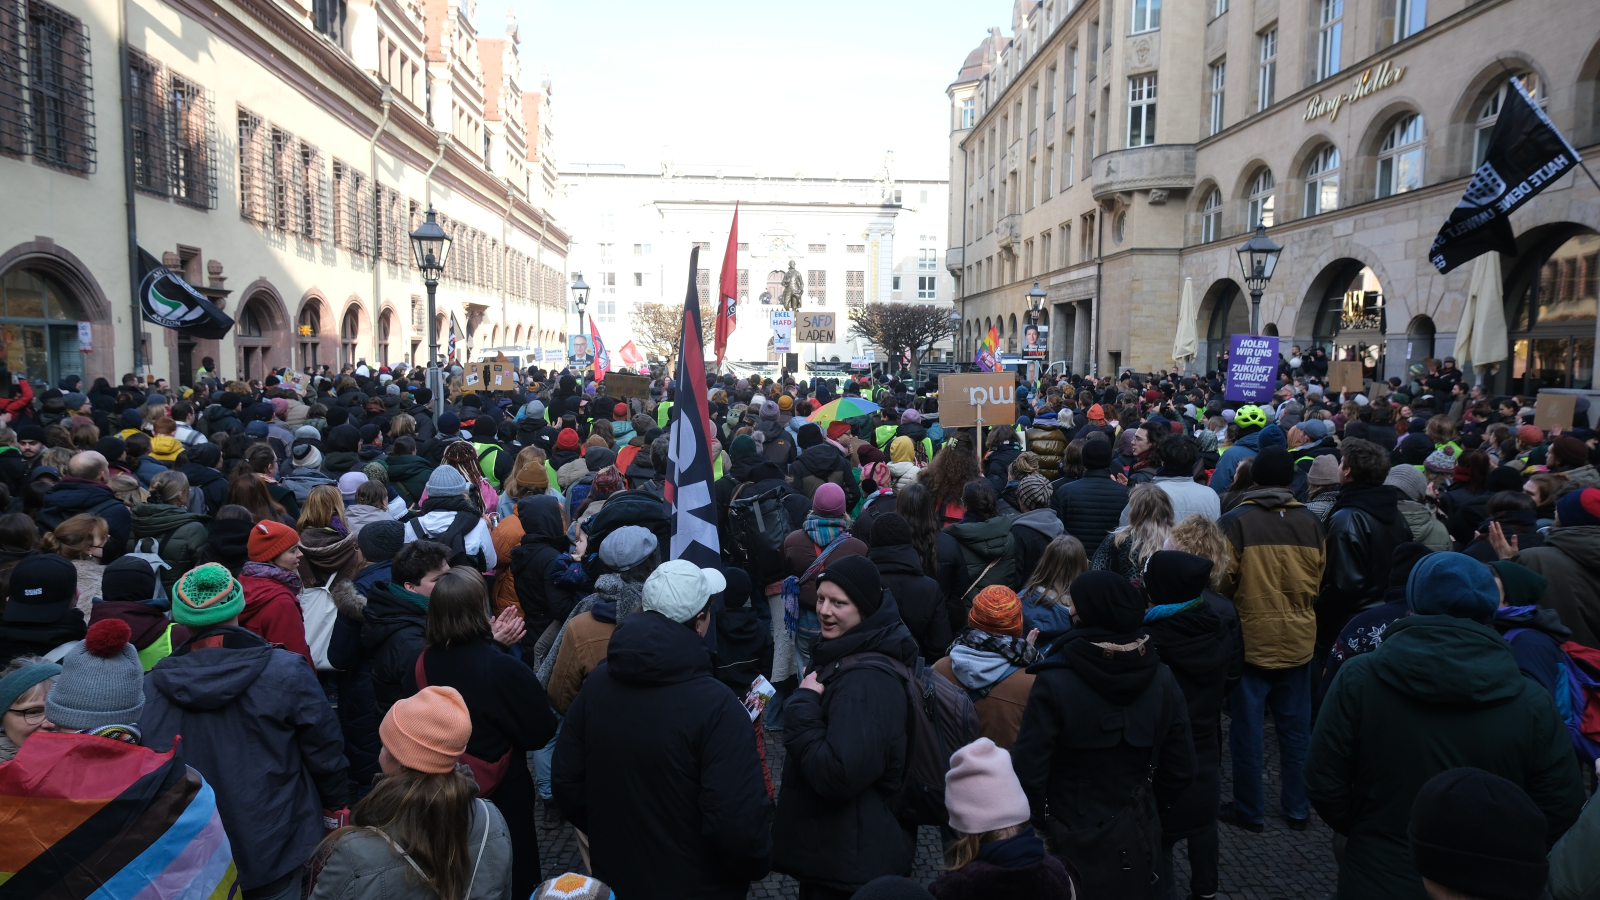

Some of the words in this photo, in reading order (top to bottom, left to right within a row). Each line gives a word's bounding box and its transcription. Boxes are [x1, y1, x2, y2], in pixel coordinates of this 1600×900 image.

[803, 314, 833, 328] SAFD
[798, 329, 834, 342] LADEN
[1240, 339, 1269, 348] HOLEN
[1254, 349, 1272, 357] UNS
[1231, 364, 1273, 373] ZUKUNFT
[1233, 372, 1269, 382] ZURÜCK
